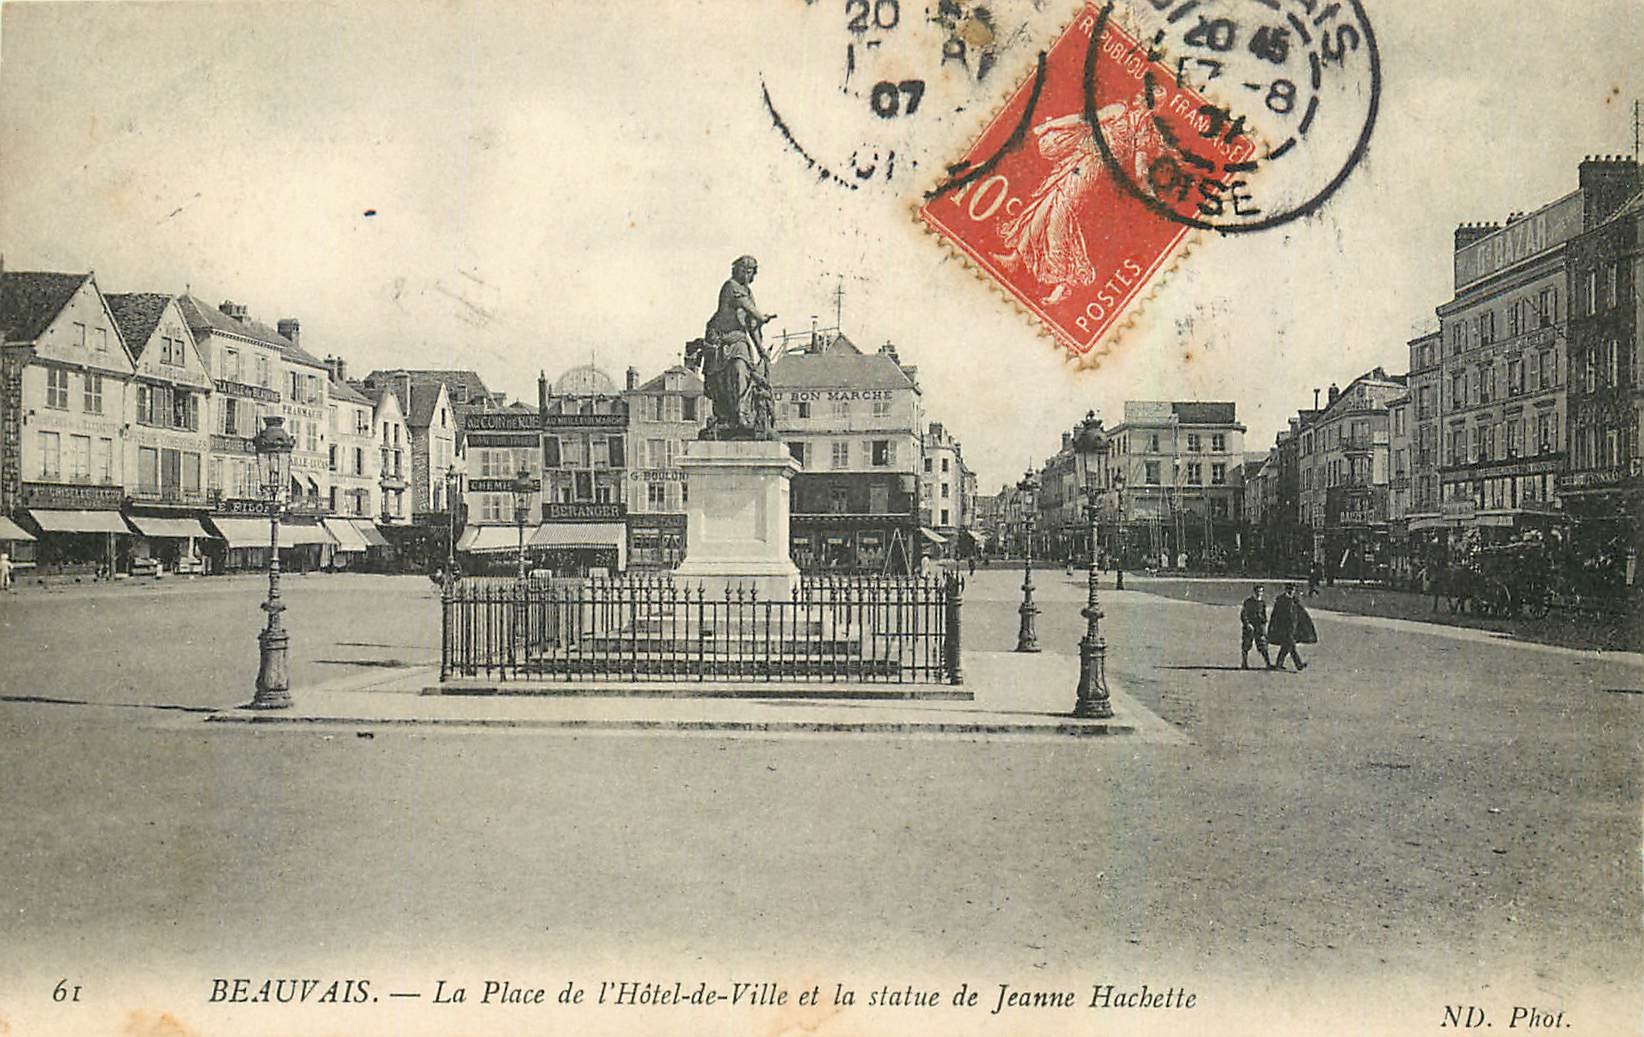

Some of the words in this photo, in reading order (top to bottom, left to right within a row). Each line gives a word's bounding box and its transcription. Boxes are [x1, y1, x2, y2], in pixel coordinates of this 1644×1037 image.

[871, 79, 926, 119] 07
[1075, 258, 1143, 333] POSTES
[790, 391, 821, 401] BON
